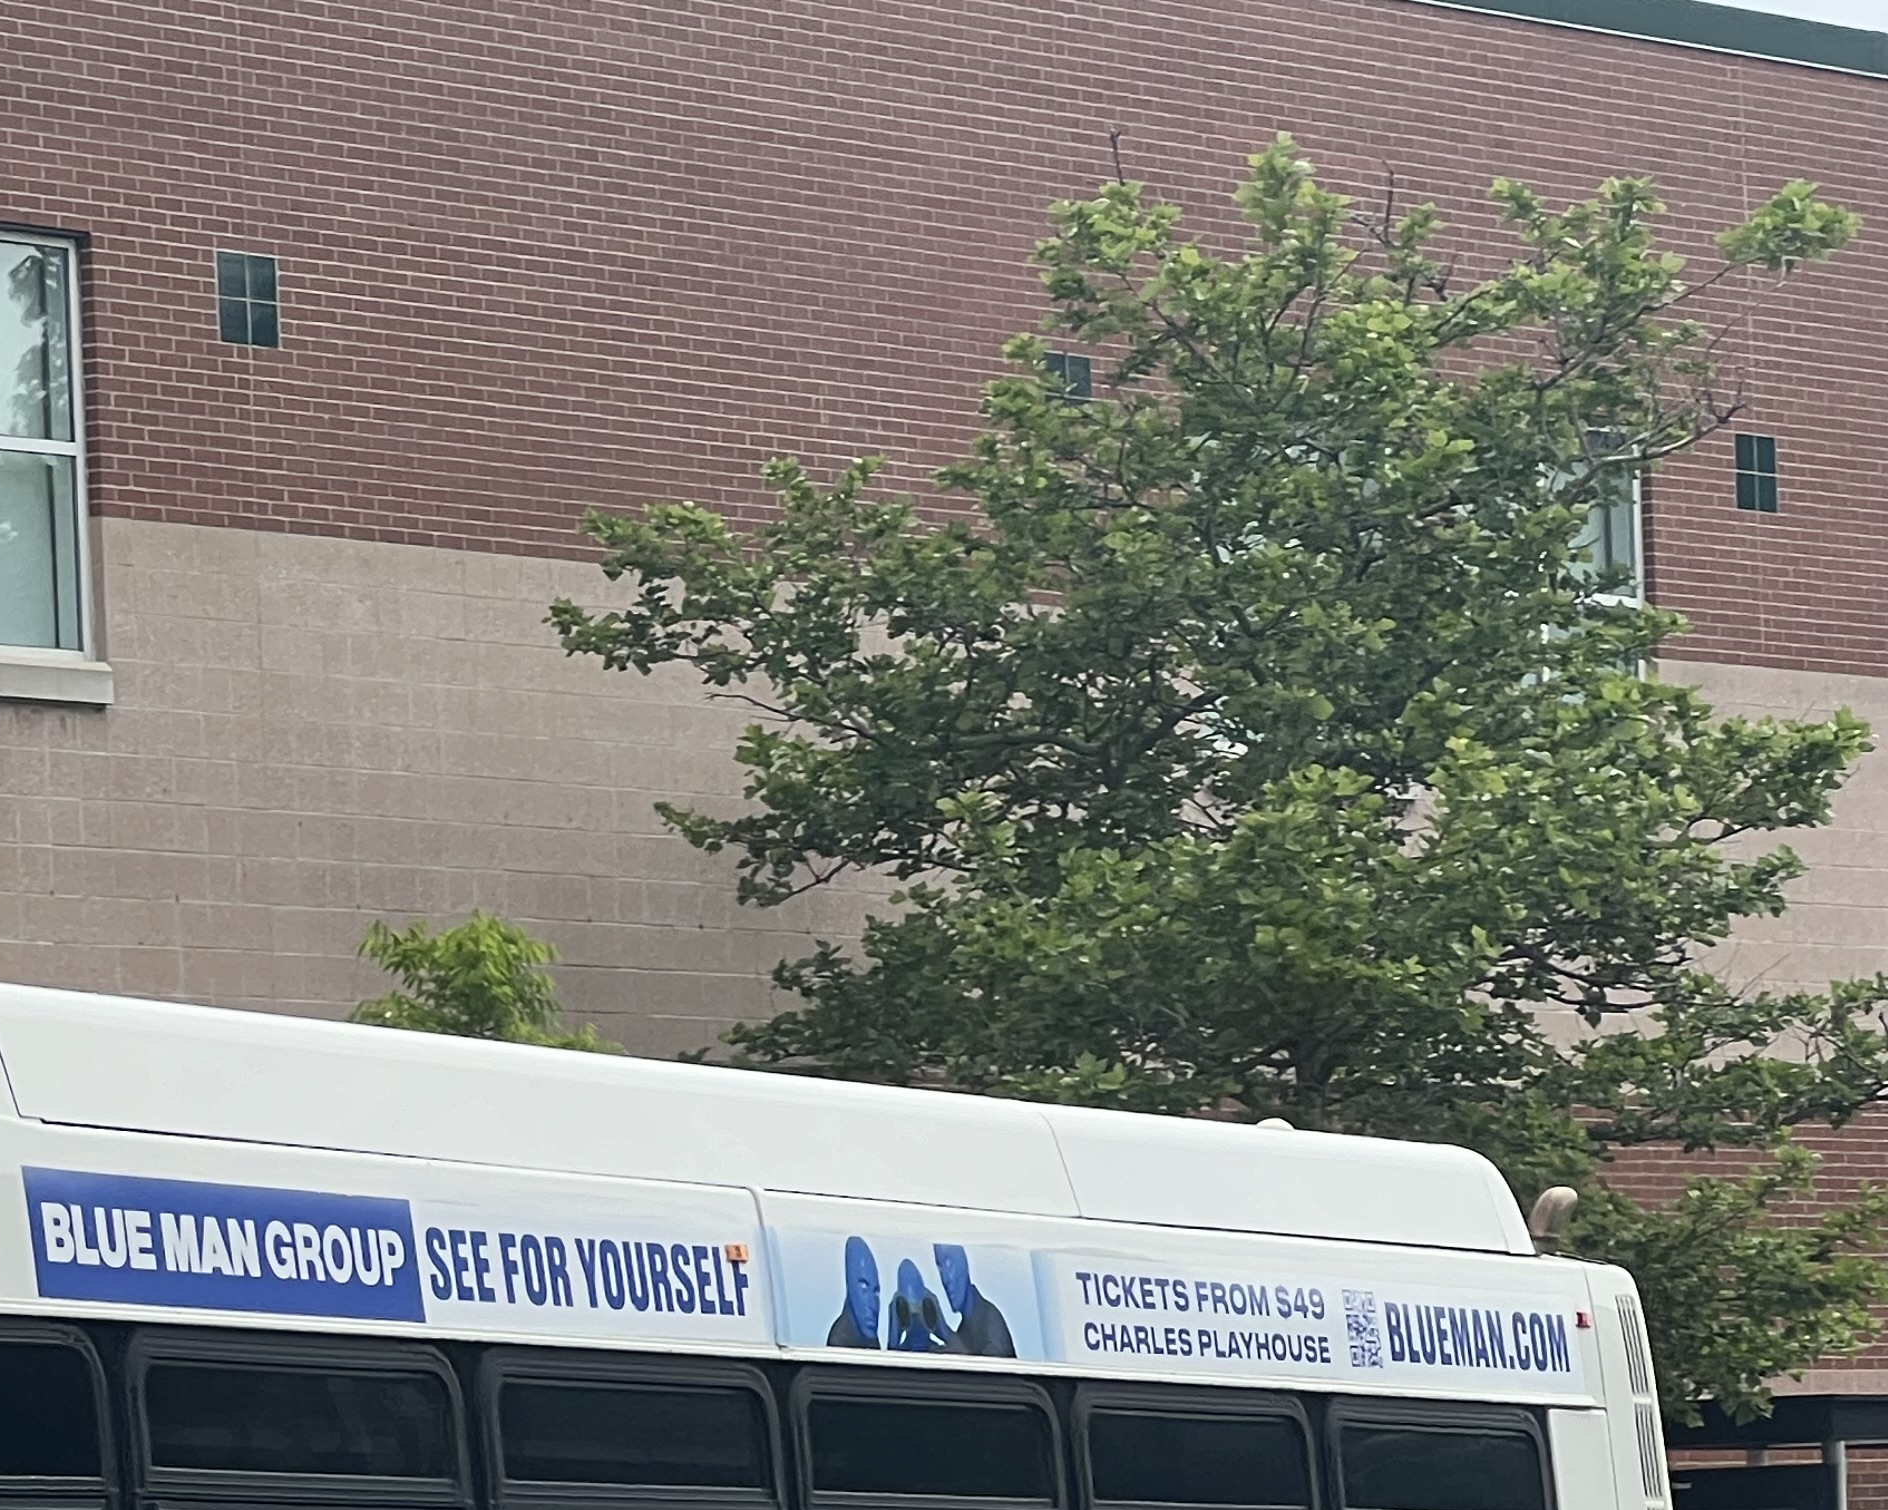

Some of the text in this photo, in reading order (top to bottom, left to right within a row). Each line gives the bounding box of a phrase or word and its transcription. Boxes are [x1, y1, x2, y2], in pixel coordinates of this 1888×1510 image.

[42, 1202, 407, 1287] BLUE MAN GROUP
[425, 1226, 750, 1317] SEE FOR YOURSELF
[1075, 1272, 1326, 1322] TICKETS FROM $49
[1082, 1322, 1332, 1365] CHARLES PLAYHOUSE
[1385, 1300, 1572, 1374] BLUEMAN.COM
